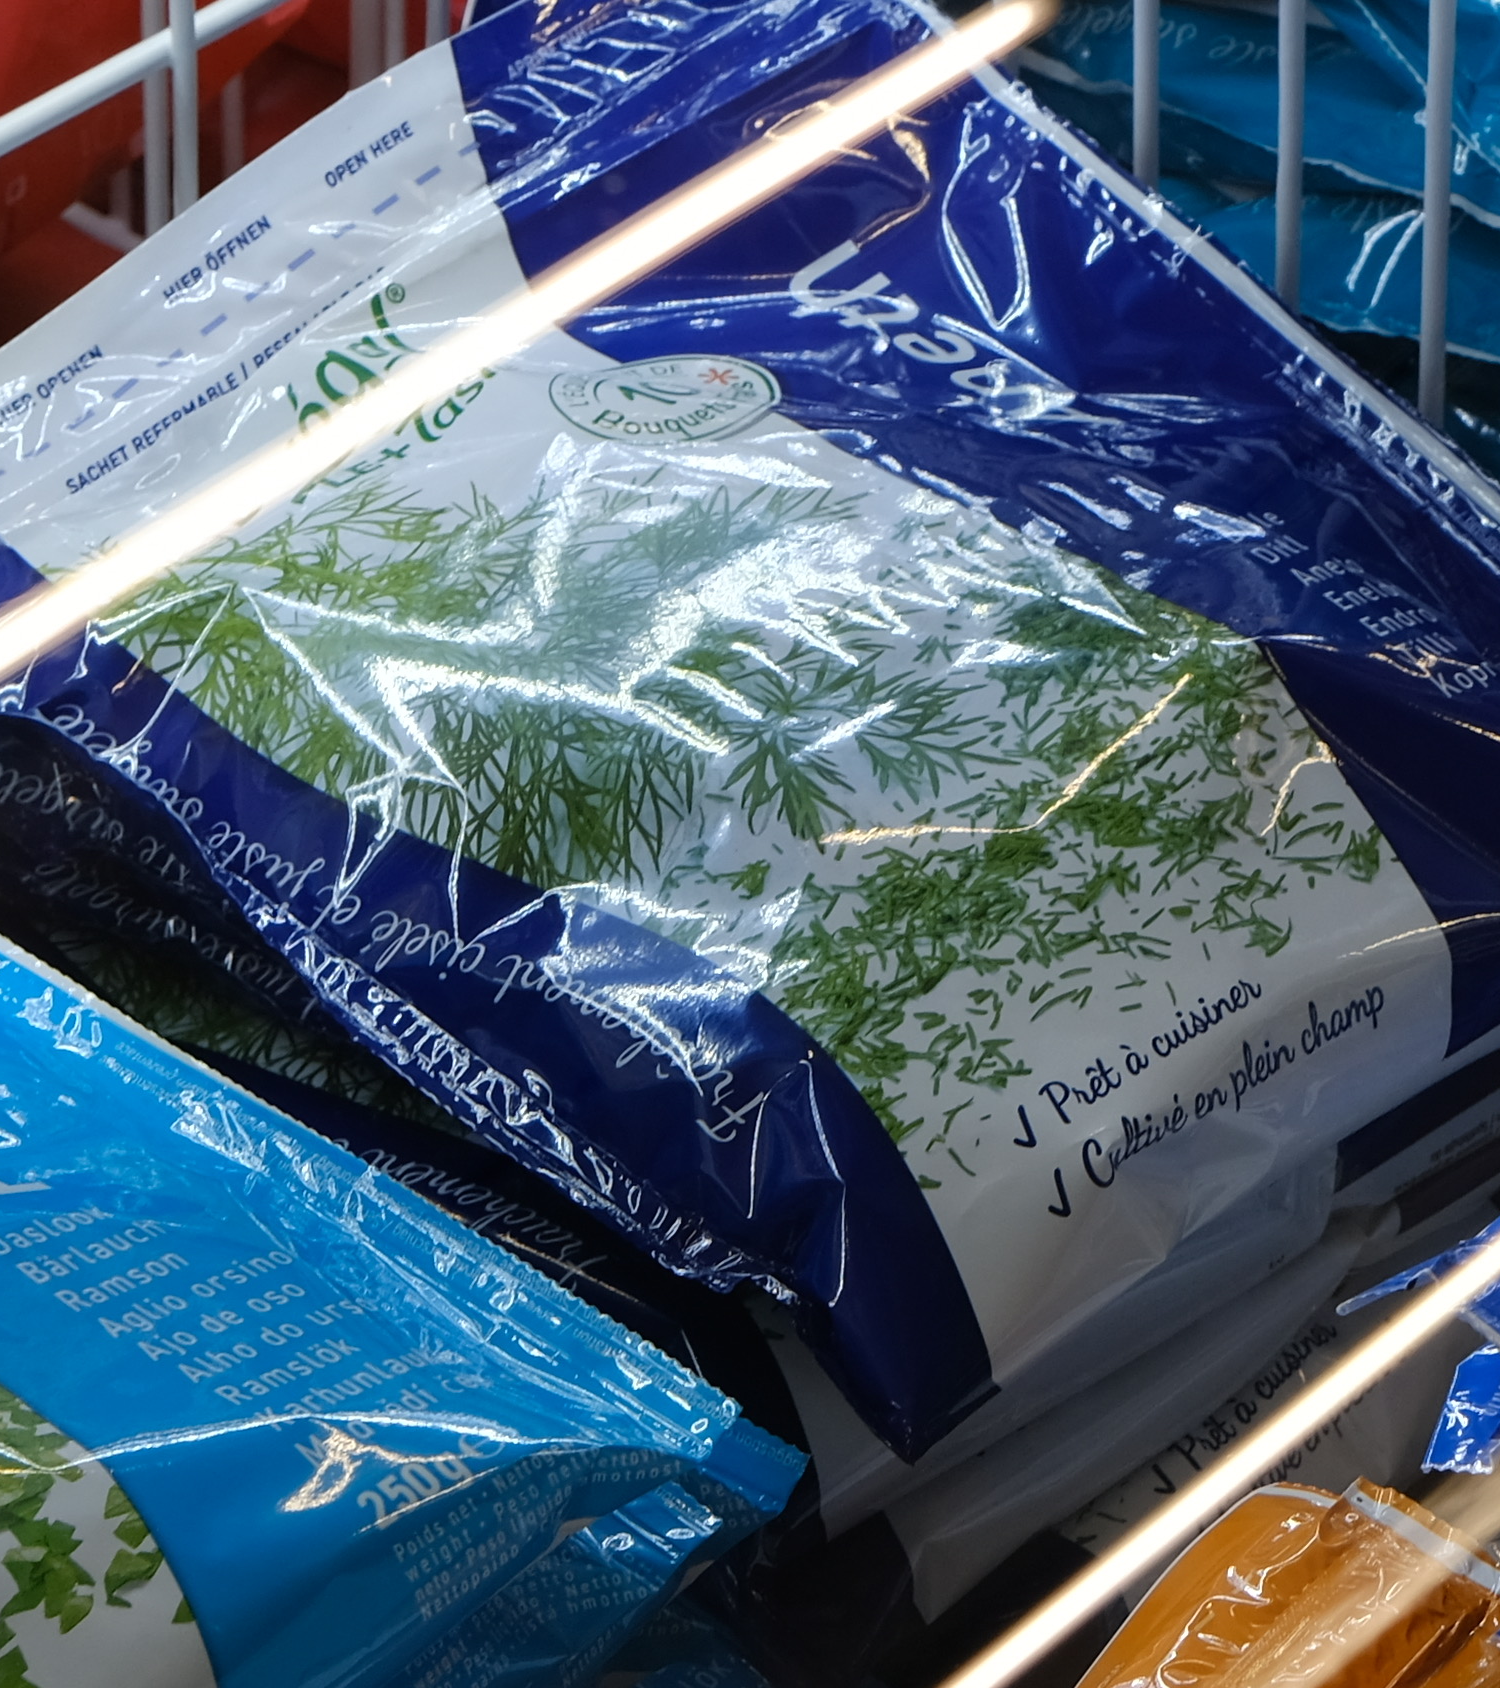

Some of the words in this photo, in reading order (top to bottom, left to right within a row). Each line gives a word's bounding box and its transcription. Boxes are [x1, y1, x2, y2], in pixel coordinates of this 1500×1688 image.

[323, 149, 368, 189] OPEN
[369, 120, 415, 162] HERE
[162, 265, 204, 303] HIER
[202, 214, 274, 271] ÖFFNEN
[35, 344, 105, 401] OPENEN
[64, 444, 130, 496] SACHET
[208, 820, 330, 910] juste
[371, 909, 487, 978] ciselé
[1037, 1057, 1123, 1125] Prêt
[1118, 1043, 1150, 1077] à
[1151, 978, 1263, 1059] cuisiner
[1081, 1093, 1190, 1189] Cultivé
[1194, 1089, 1229, 1117] en
[1228, 1039, 1297, 1113] plein
[1300, 984, 1385, 1056] champ
[15, 1216, 170, 1286] Bärlauch
[53, 1248, 191, 1314] Ramson
[97, 1293, 190, 1340] Aglio
[190, 1245, 298, 1301] orsino
[136, 1325, 198, 1363] Ajo
[197, 1304, 235, 1335] de
[245, 1281, 308, 1315] oso
[176, 1343, 259, 1385] Alho
[259, 1320, 306, 1348] do
[305, 1293, 379, 1328] urso
[213, 1335, 363, 1408] Ramslök
[357, 1453, 473, 1530] 250g
[393, 1526, 442, 1564] Poids
[443, 1494, 480, 1530] net
[403, 1538, 467, 1583] weight
[464, 1534, 510, 1565] Peso
[420, 1542, 522, 1623] Nettopaino
